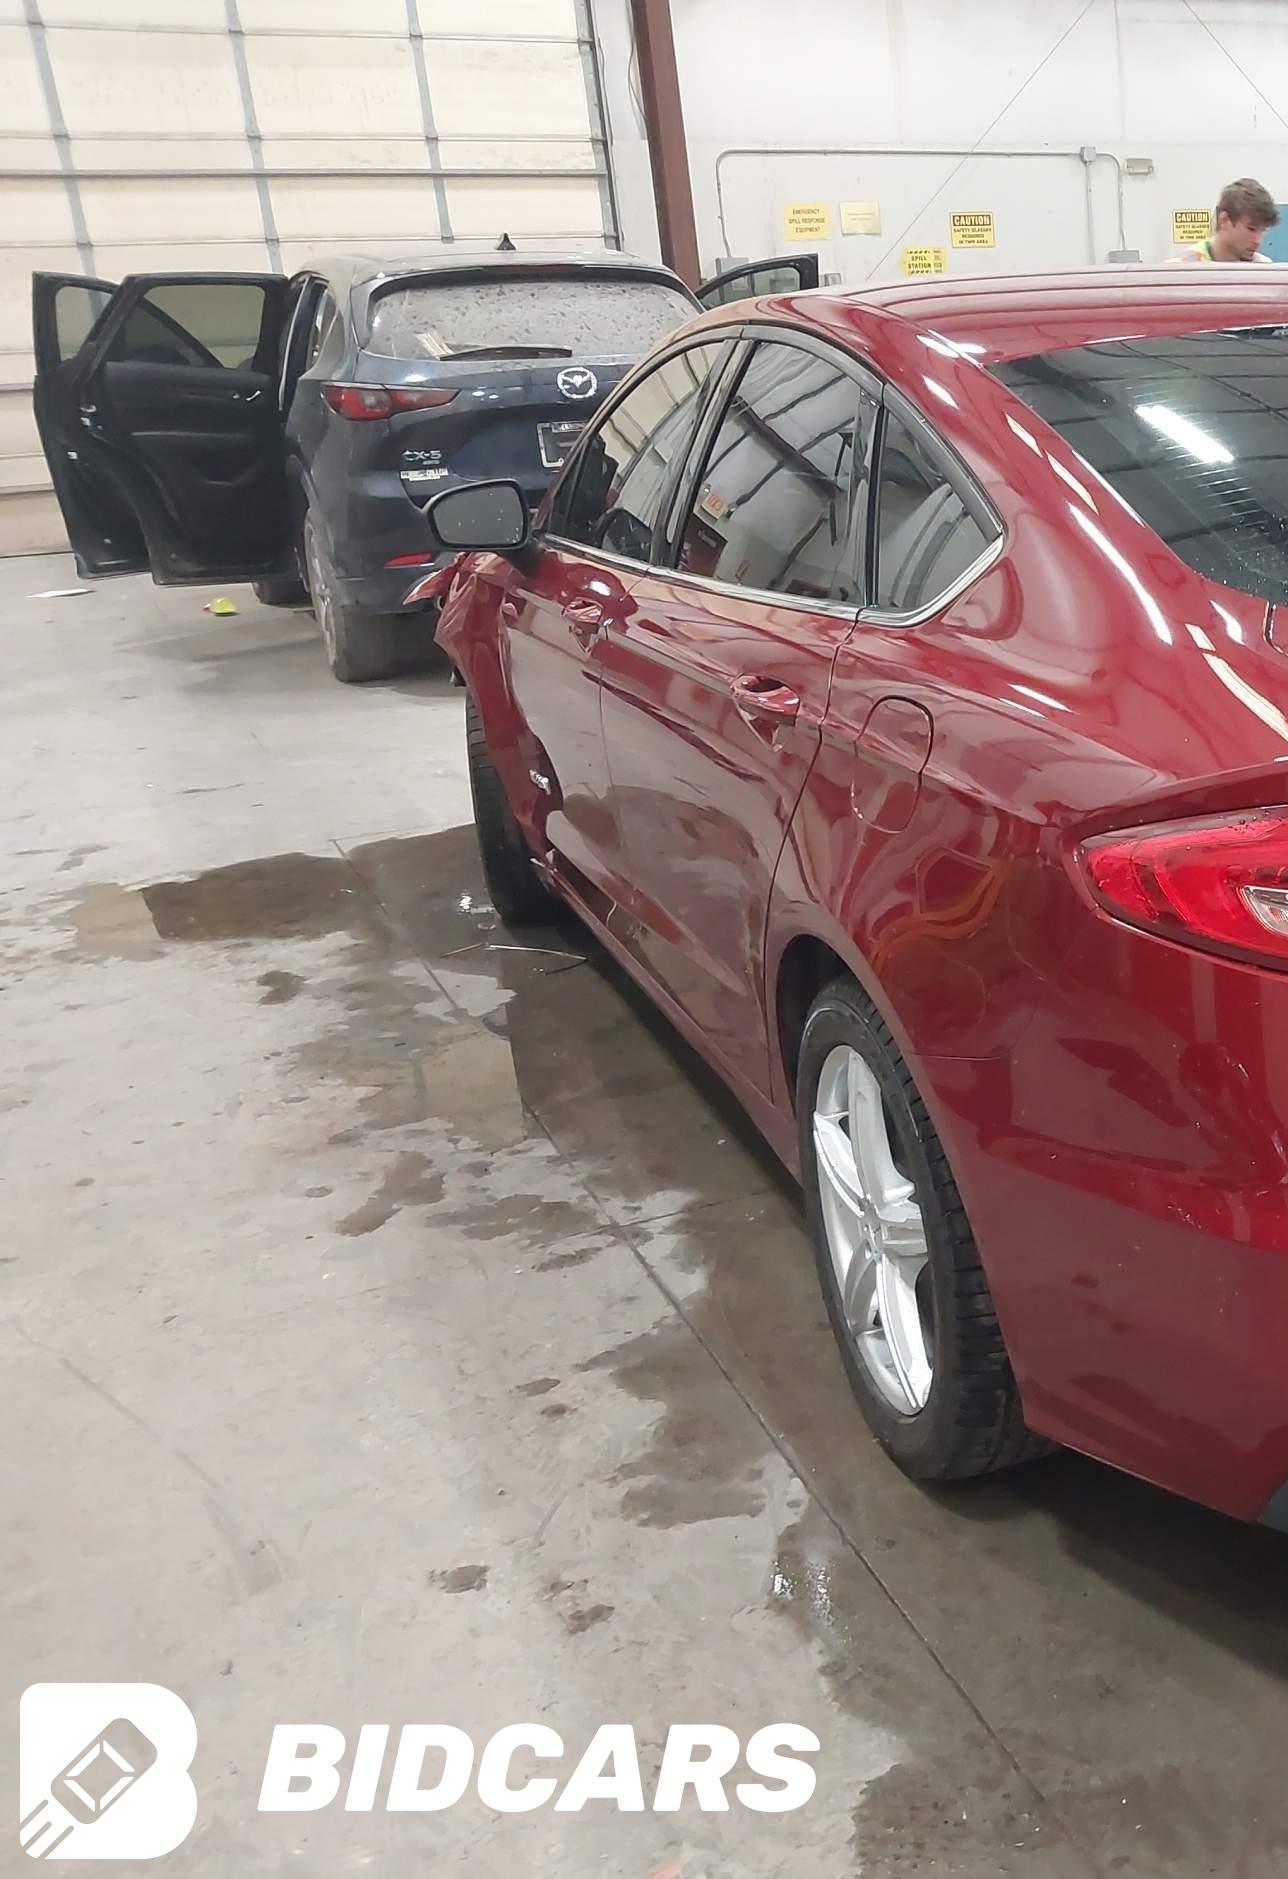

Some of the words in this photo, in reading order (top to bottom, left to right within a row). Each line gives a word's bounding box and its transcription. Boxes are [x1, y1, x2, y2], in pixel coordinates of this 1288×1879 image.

[954, 215, 990, 225] CAUTION
[1176, 212, 1208, 222] CAUTION
[402, 450, 442, 461] CX-5
